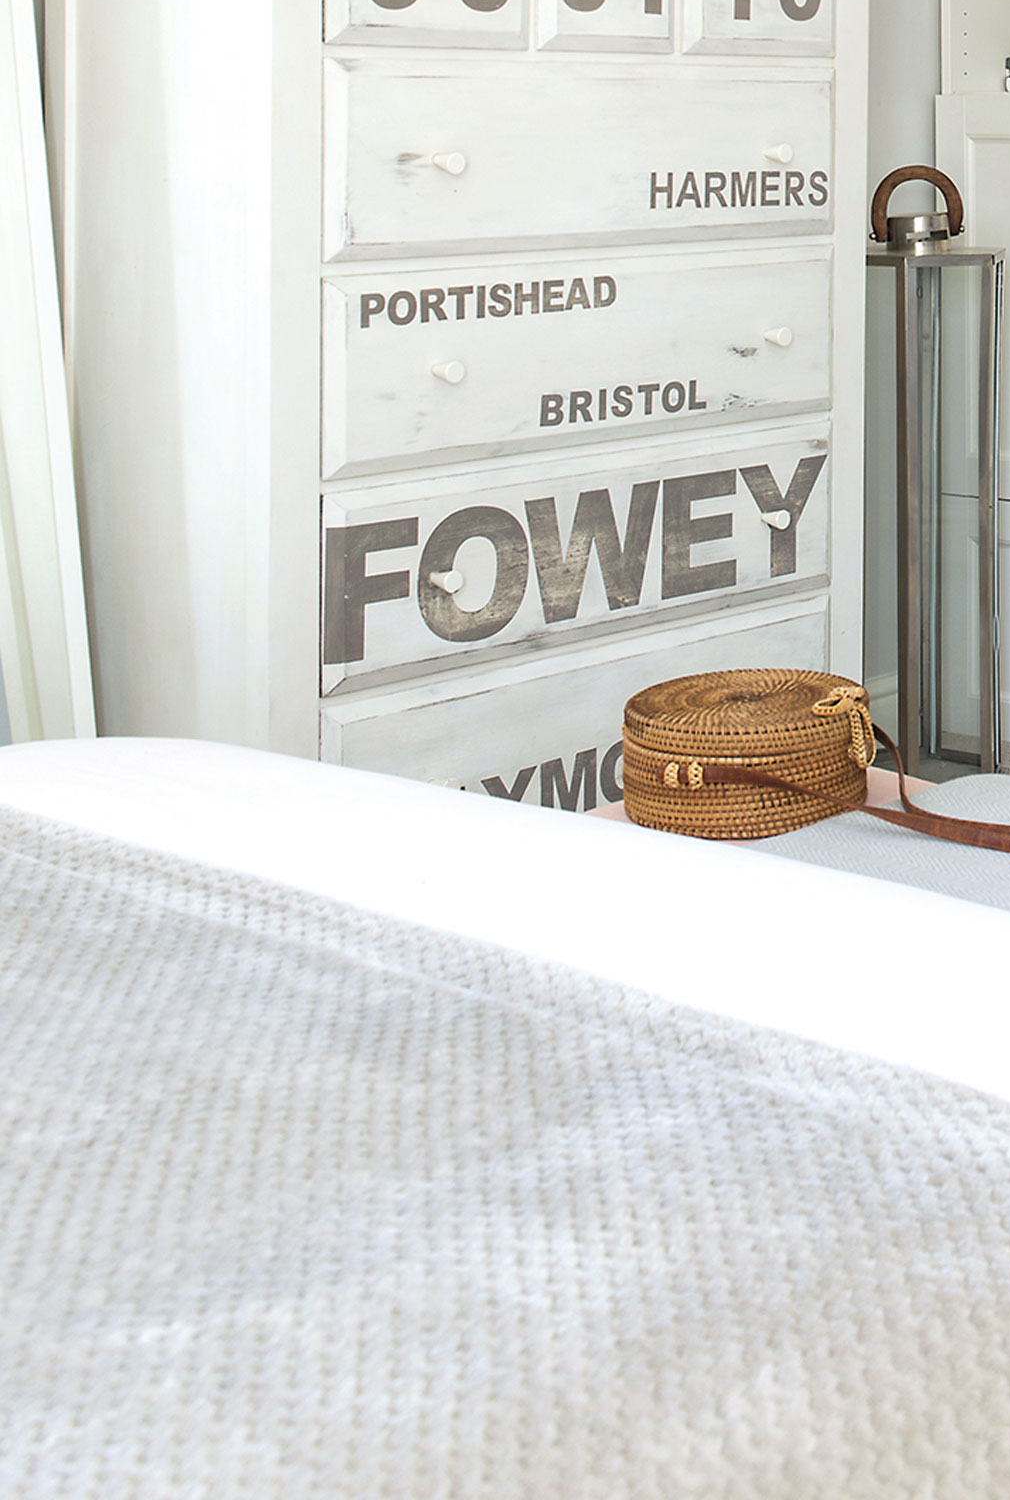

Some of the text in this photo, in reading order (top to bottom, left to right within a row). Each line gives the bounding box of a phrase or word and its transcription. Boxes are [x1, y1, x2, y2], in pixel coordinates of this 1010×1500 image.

[648, 170, 829, 210] HARMERS
[359, 275, 617, 329] PORTISHEAD
[539, 379, 708, 428] BRISTOL
[323, 454, 828, 665] FOWEY
